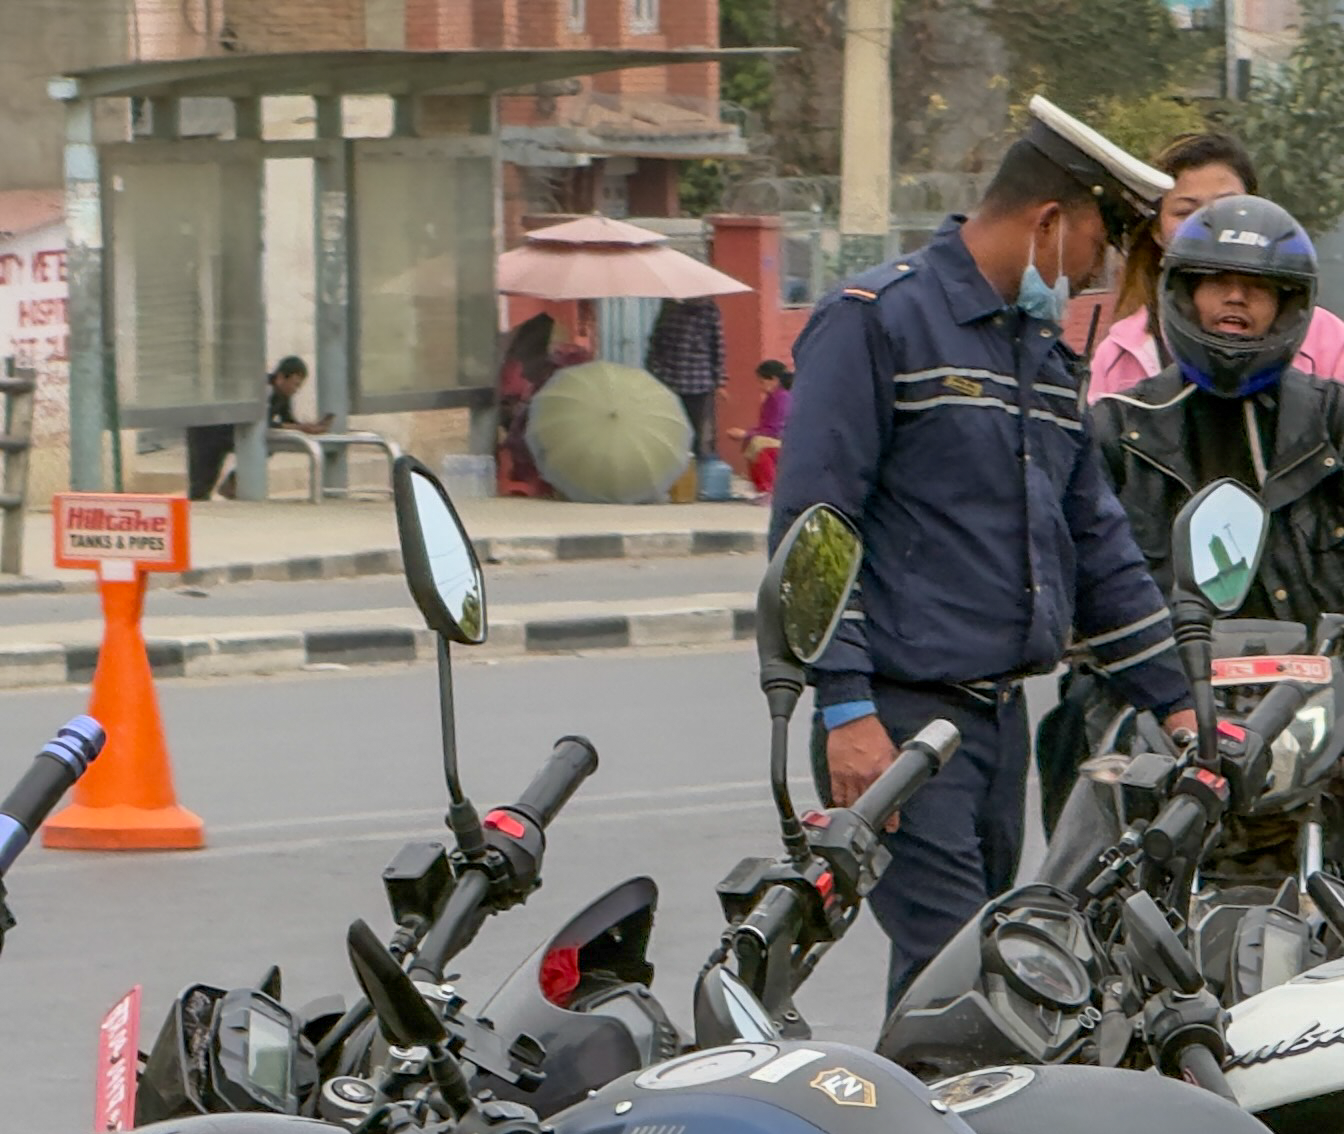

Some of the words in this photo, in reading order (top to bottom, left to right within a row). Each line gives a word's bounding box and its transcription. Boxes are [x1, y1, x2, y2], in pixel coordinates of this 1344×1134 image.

[69, 508, 166, 532] Hilltake
[70, 534, 112, 549] TANKS
[115, 535, 124, 549] &
[128, 536, 164, 550] PIPES
